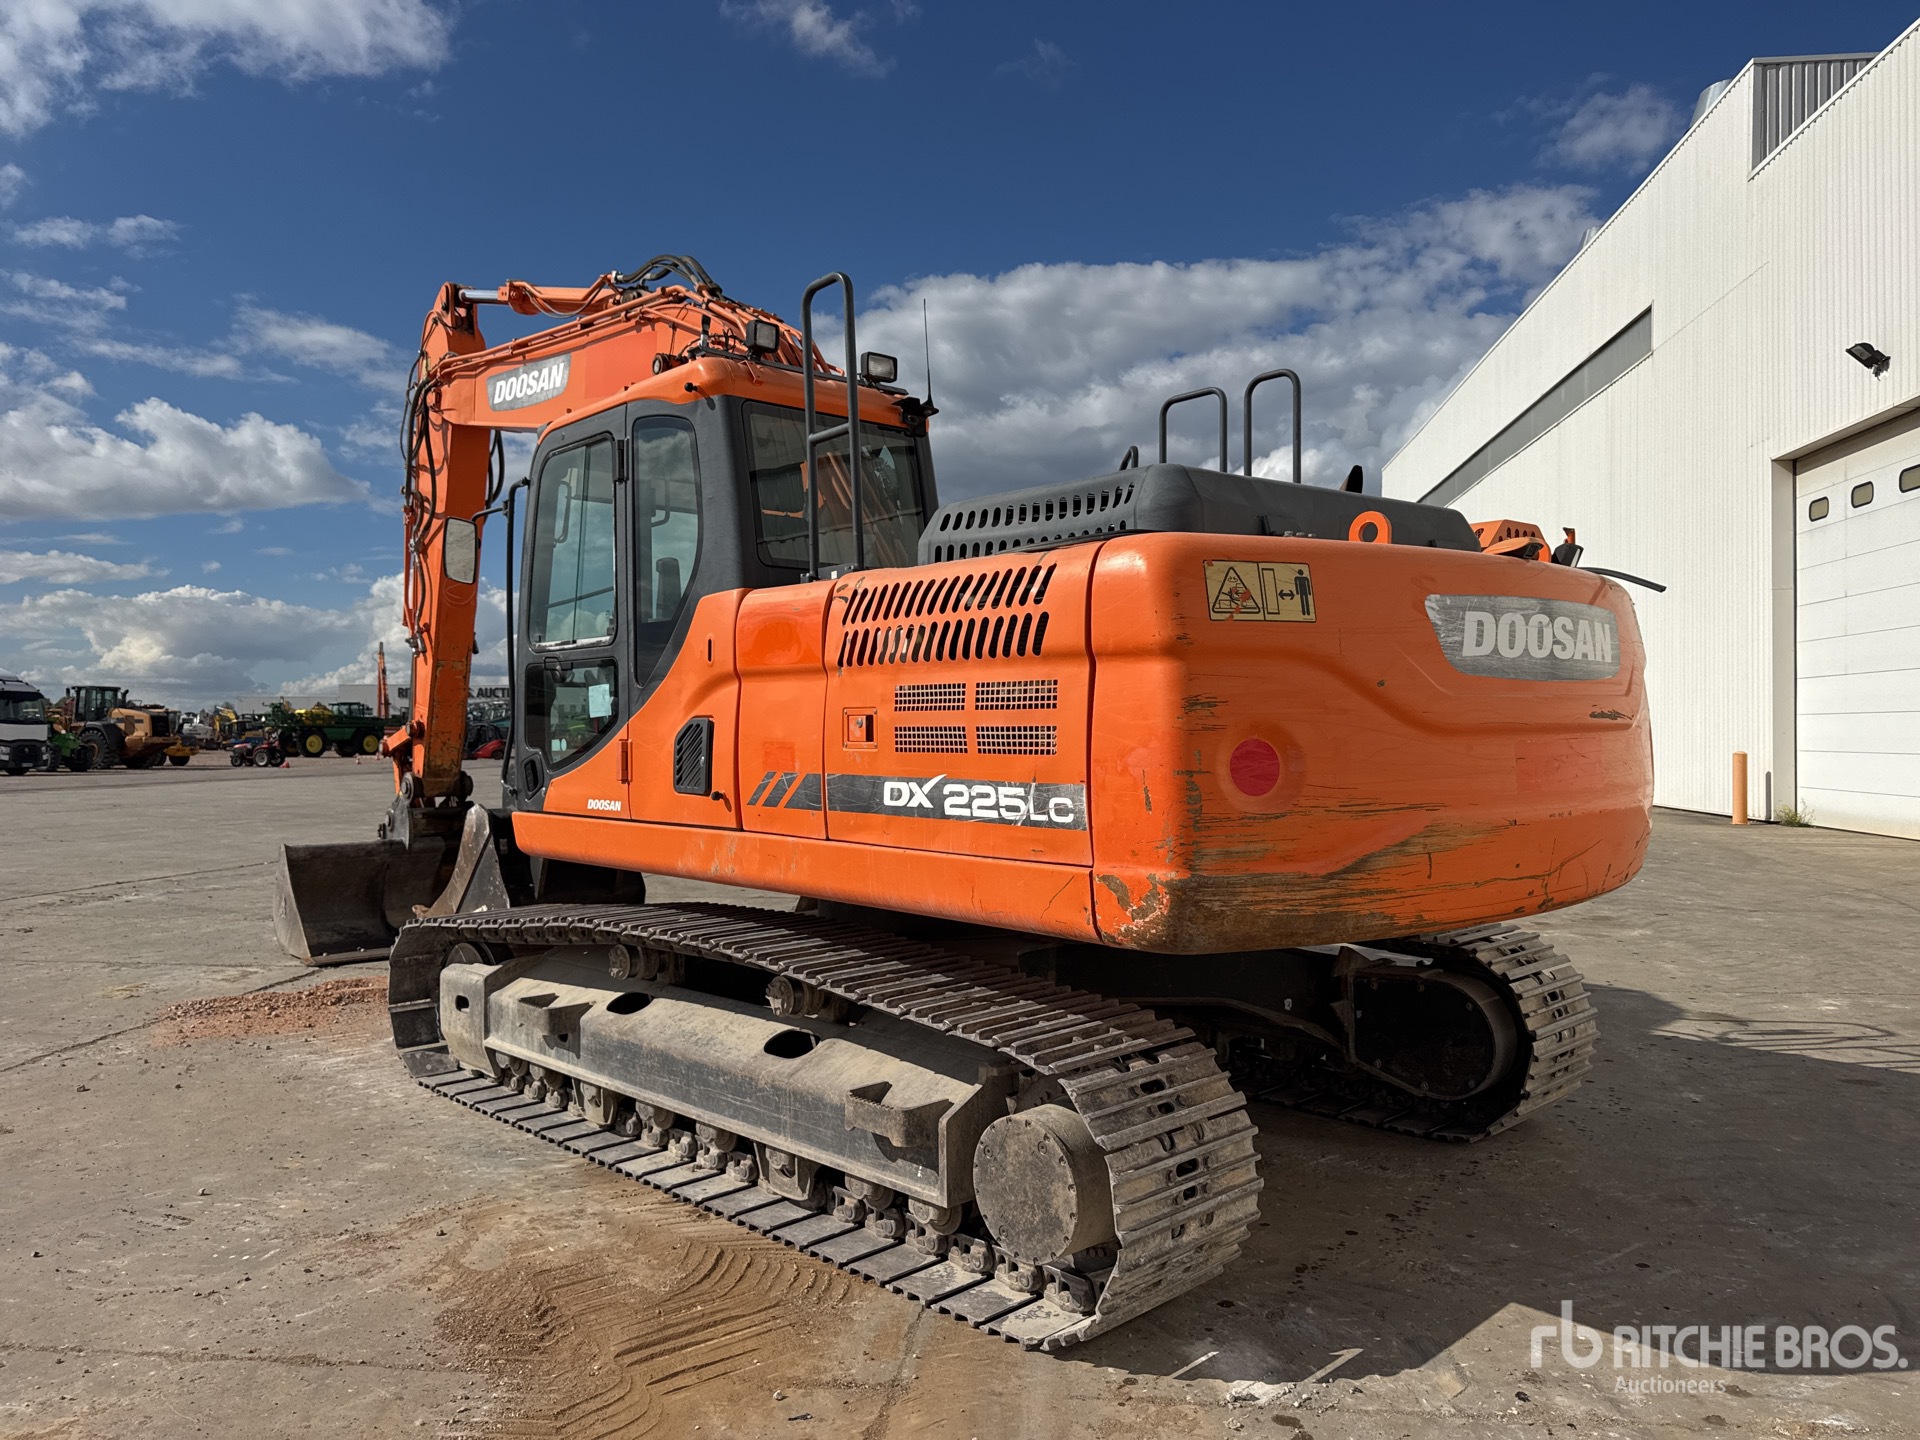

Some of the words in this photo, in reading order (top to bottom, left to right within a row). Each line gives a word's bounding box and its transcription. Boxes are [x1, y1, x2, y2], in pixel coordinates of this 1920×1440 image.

[494, 363, 565, 404] DOOSAN
[1462, 611, 1612, 663] DOOSAN
[587, 799, 622, 811] DOOSAN
[884, 774, 948, 808] DX
